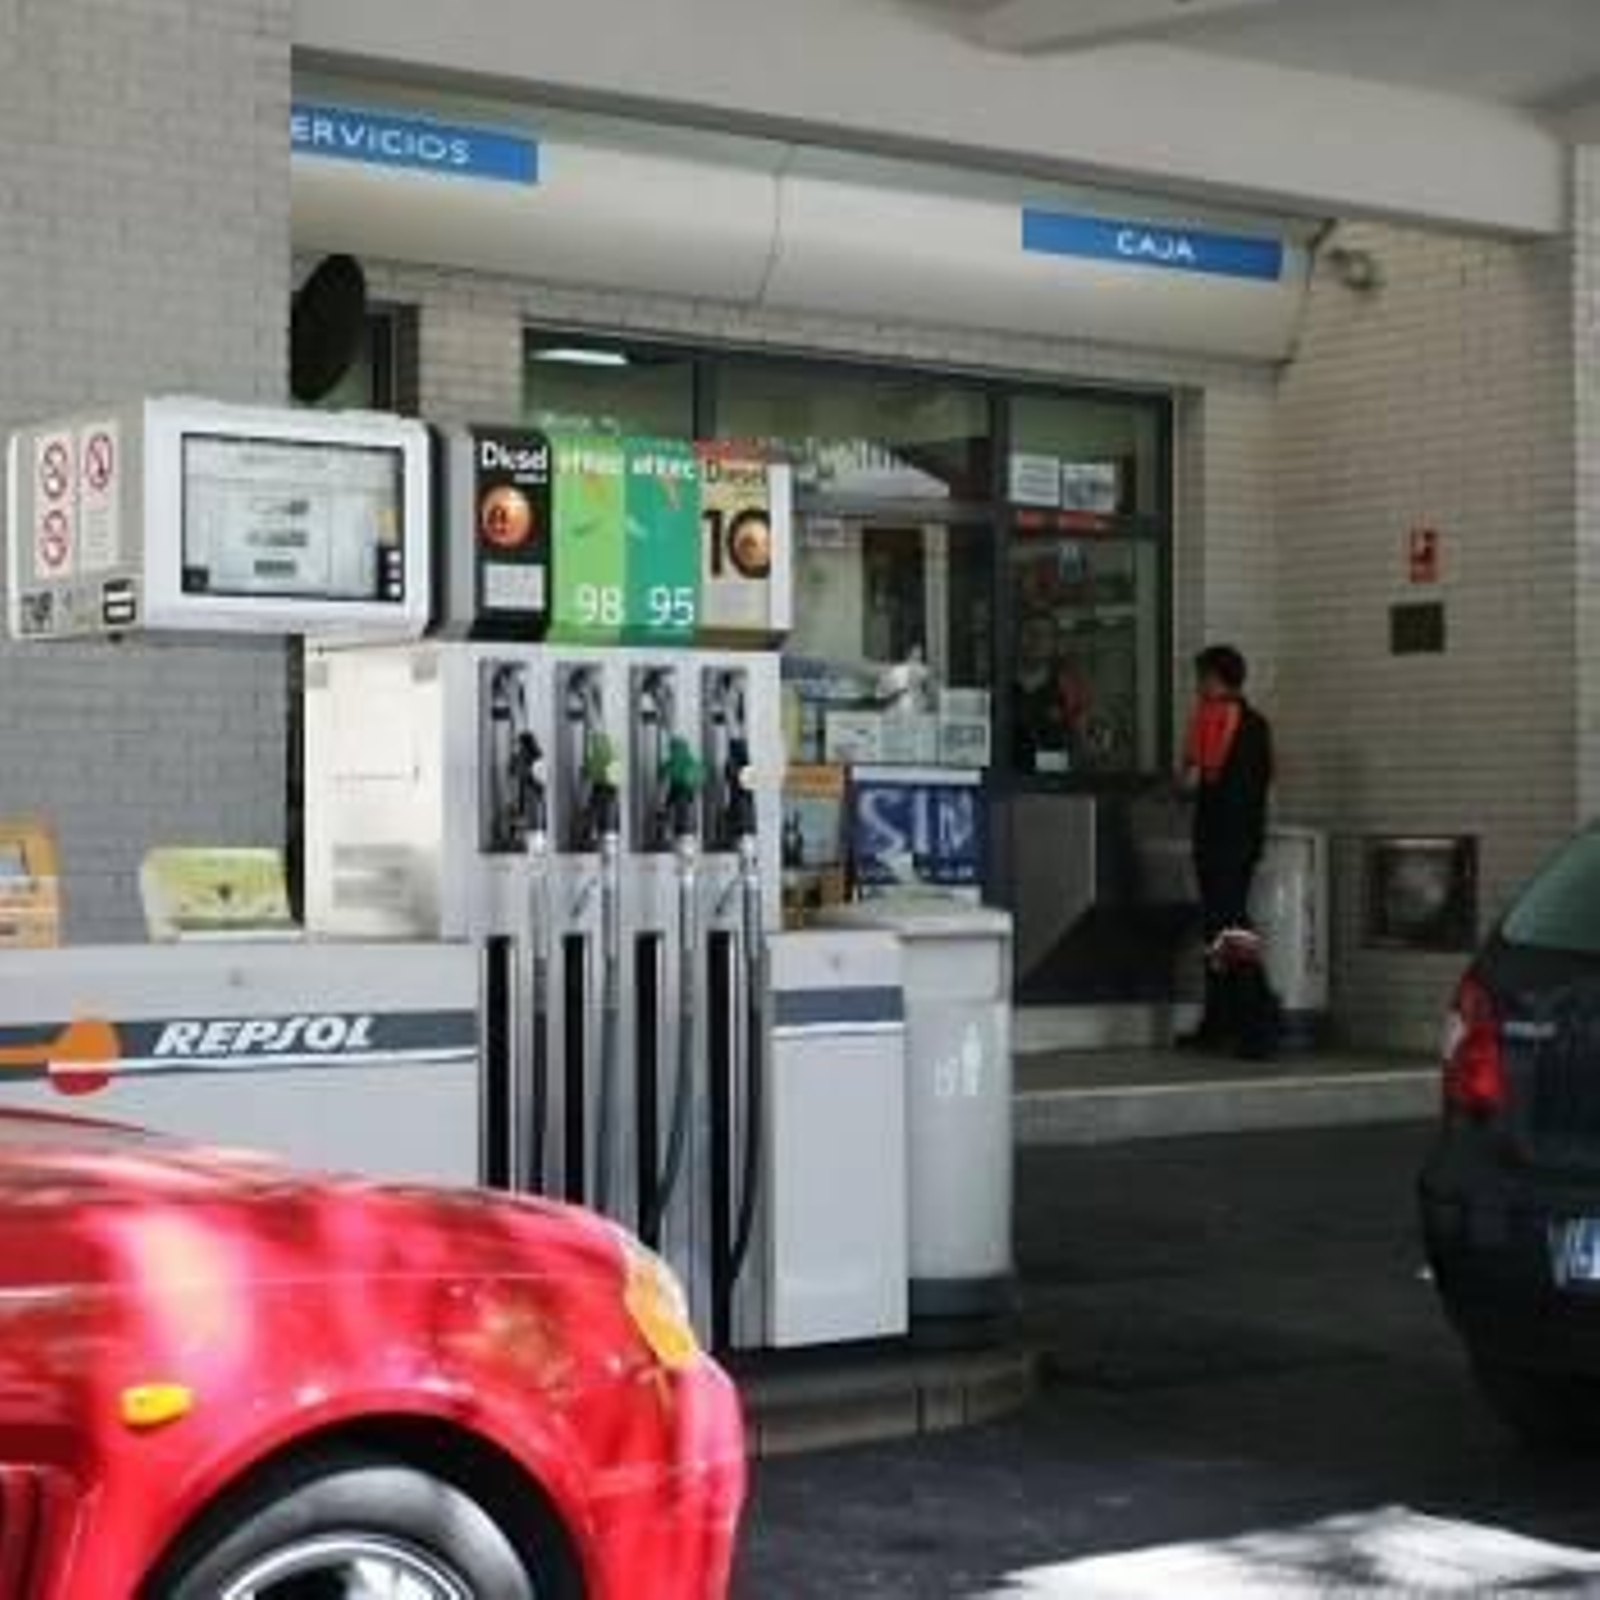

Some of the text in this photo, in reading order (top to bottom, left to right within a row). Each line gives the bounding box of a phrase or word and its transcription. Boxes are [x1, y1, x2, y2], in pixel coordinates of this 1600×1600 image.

[1116, 229, 1196, 264] CAJA
[481, 440, 547, 470] Diesel
[703, 508, 771, 580] 10
[577, 584, 625, 626] 98
[649, 586, 694, 627] 95
[152, 1016, 375, 1056] REPSOL
